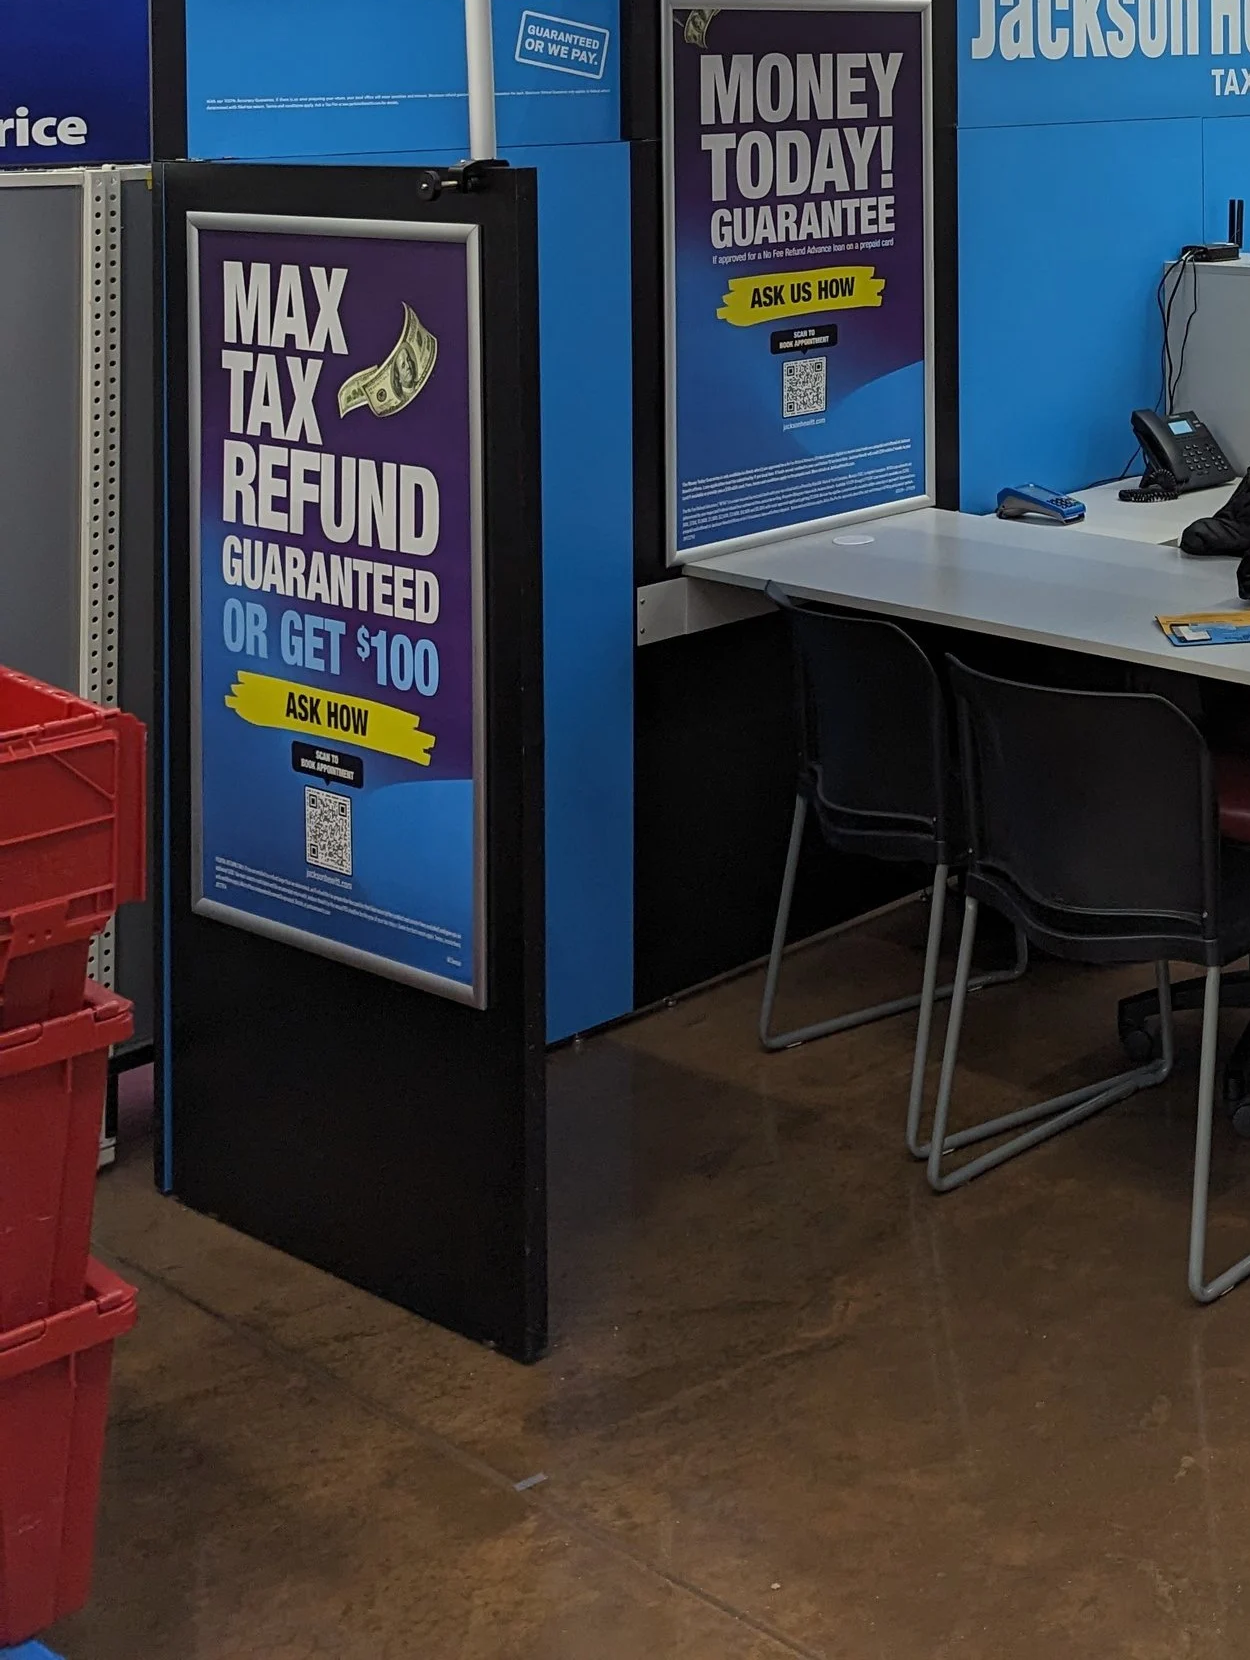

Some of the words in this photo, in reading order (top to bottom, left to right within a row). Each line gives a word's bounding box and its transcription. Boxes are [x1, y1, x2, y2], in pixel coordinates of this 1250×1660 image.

[525, 38, 544, 53] OR
[547, 43, 568, 59] WE
[571, 48, 599, 66] PAY.
[528, 24, 600, 50] GUARANTEED
[700, 52, 903, 125] MONEY
[701, 126, 893, 202] TODAY!
[711, 196, 895, 249] GUARANTEE
[712, 255, 717, 265] If
[718, 253, 747, 265] approved
[747, 252, 756, 261] for
[763, 250, 772, 259] No
[772, 249, 784, 259] Fee
[785, 246, 806, 257] Refund
[807, 244, 832, 255] Advance
[833, 243, 845, 252] loan
[846, 243, 854, 251] on
[859, 239, 881, 251] prepaid
[881, 237, 894, 248] card
[223, 261, 349, 355] MAX
[751, 285, 786, 308] ASK
[790, 281, 812, 303] US
[817, 277, 855, 299] HOW
[793, 329, 808, 340] SCAN
[808, 328, 815, 338] TO
[222, 349, 323, 445] TAX
[223, 439, 440, 556] REFUND
[222, 535, 439, 625] GUARANTEED
[223, 598, 268, 660] OR
[281, 610, 346, 676] GET
[357, 625, 439, 697] $100
[286, 691, 321, 726] ASK
[327, 703, 368, 737] HOW
[301, 758, 316, 771] BOOK
[316, 762, 354, 780] APPOINTMENT
[315, 750, 331, 761] SCAN
[332, 753, 339, 764] TO
